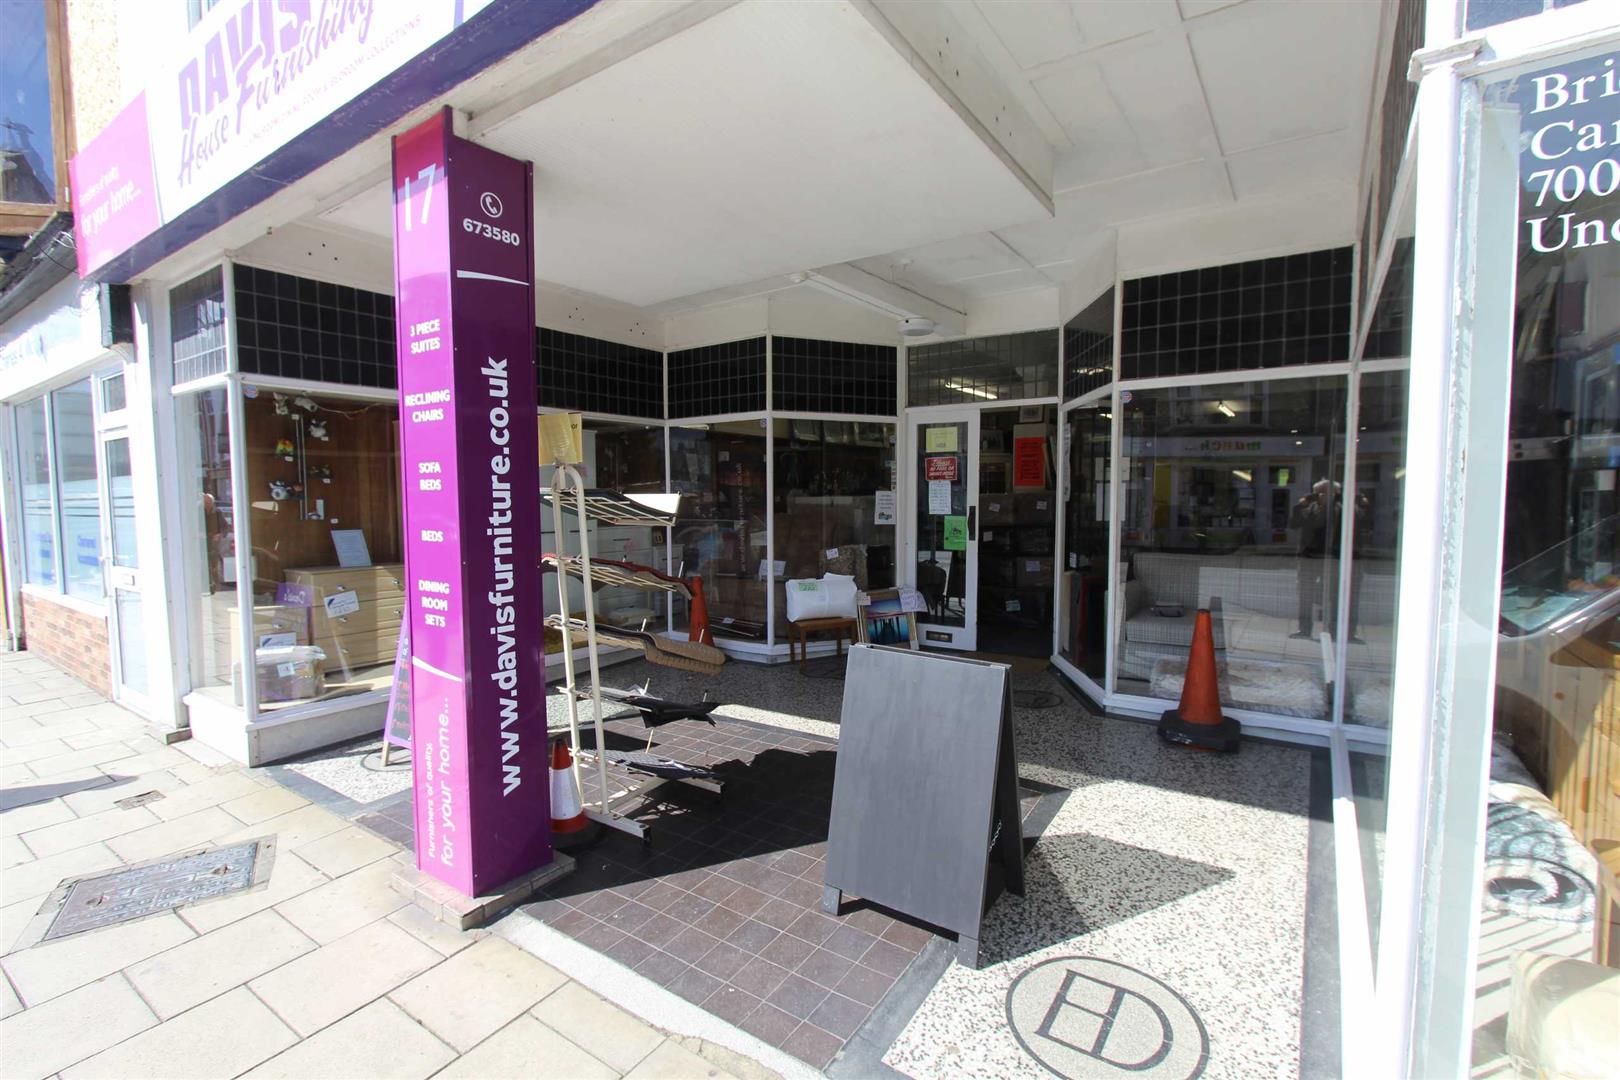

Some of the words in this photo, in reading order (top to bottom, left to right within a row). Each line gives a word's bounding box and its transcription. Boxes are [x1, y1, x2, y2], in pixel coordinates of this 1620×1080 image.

[1530, 58, 1620, 114] Bri
[177, 111, 229, 188] House
[404, 163, 437, 232] 17
[462, 217, 520, 247] 673580
[410, 324, 416, 338] 3
[416, 318, 441, 335] PIECE
[411, 337, 441, 354] SUITES
[405, 389, 450, 407] RECLINING
[412, 408, 444, 424] CHAIRS
[418, 461, 441, 474] SOFA
[419, 479, 442, 491] BEDS
[421, 530, 444, 542] BEDS
[480, 355, 522, 798] www.davisfurniture.co.uk
[418, 578, 450, 595] DINING
[422, 596, 448, 612] ROOM
[424, 613, 446, 628] SETS
[438, 780, 456, 832] your
[440, 833, 455, 866] for
